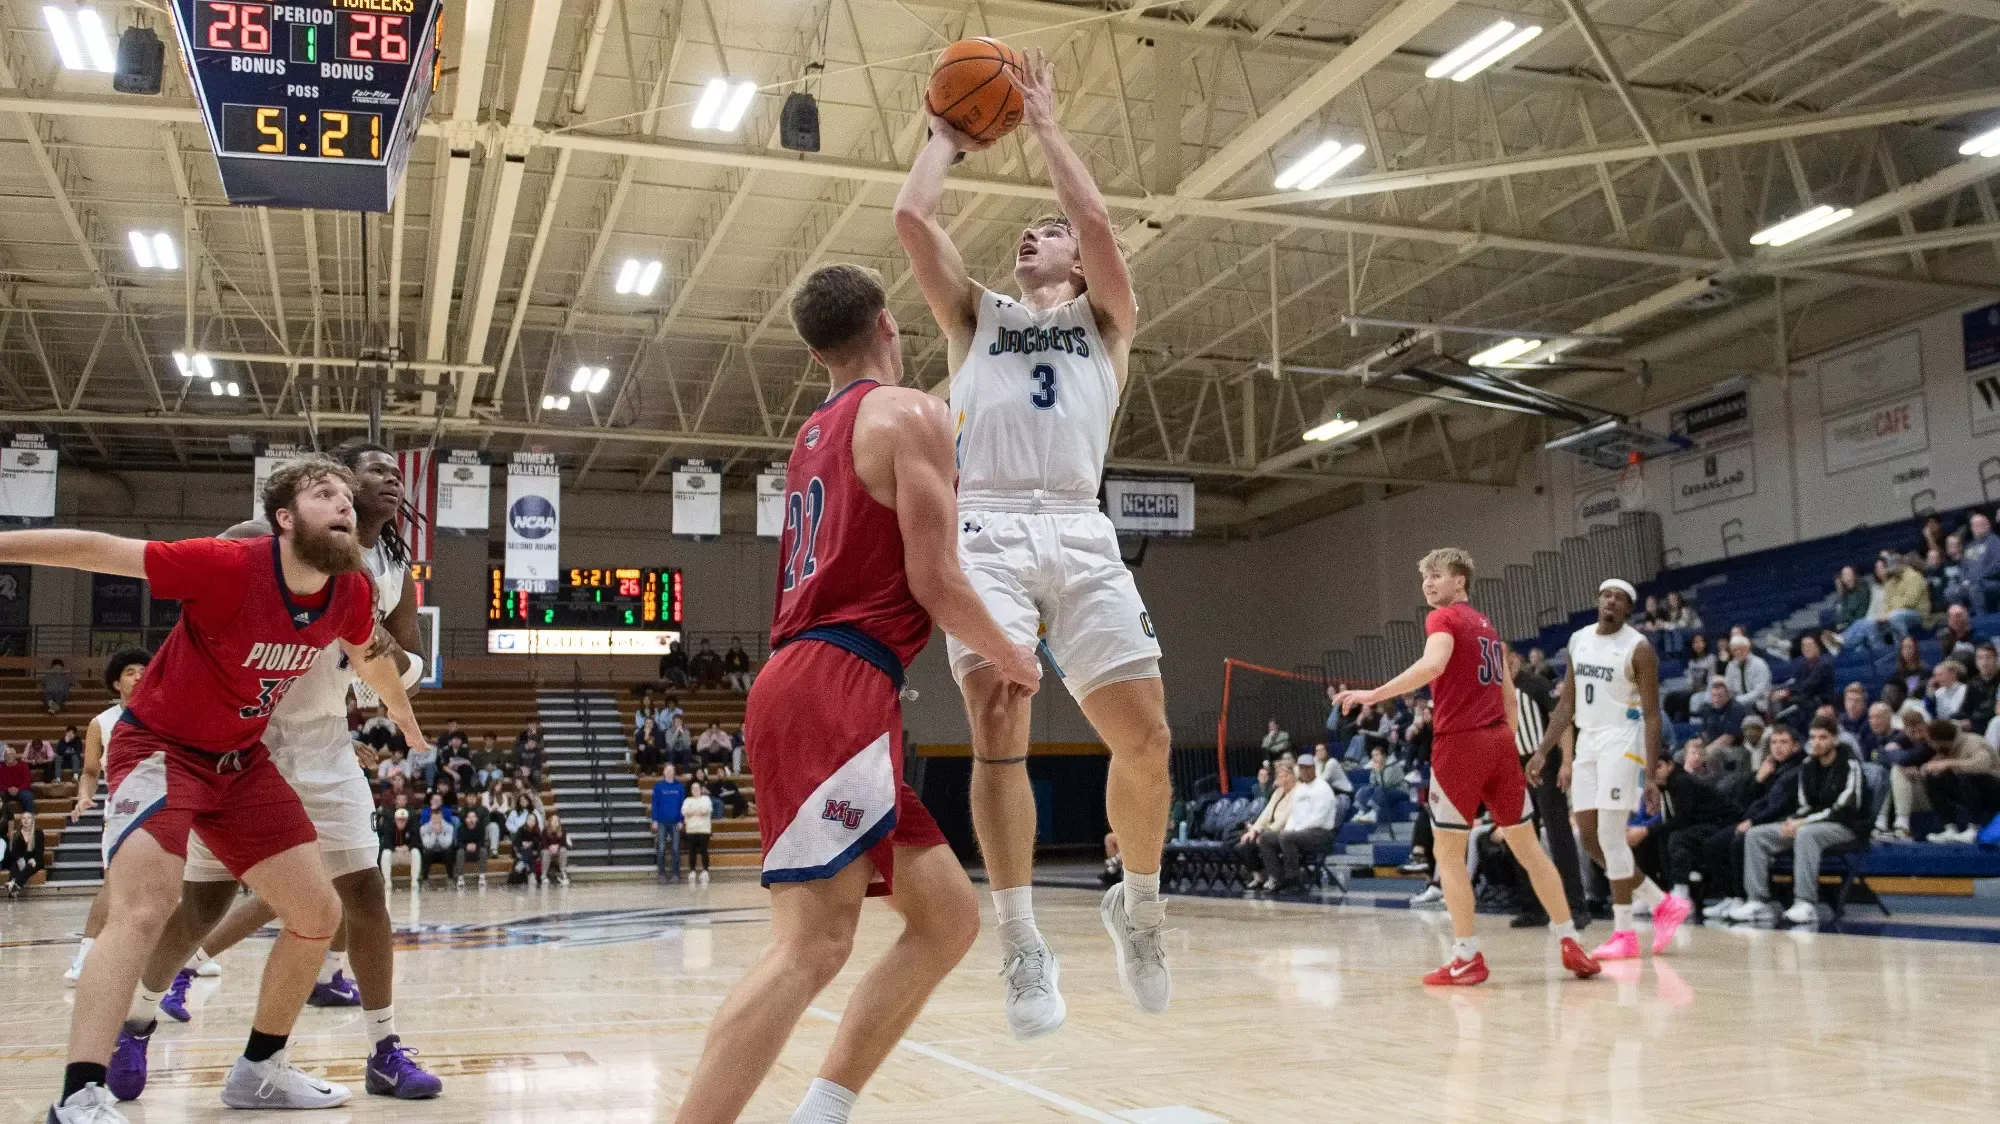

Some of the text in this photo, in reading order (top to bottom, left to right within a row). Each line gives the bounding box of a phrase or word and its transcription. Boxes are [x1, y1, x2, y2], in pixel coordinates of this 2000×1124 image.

[273, 6, 333, 25] PERIOD
[208, 3, 268, 50] 26
[307, 26, 315, 61] 1
[350, 14, 406, 61] 26
[231, 56, 286, 75] BONUS
[320, 62, 374, 81] BONUS
[287, 84, 319, 98] POSS
[256, 107, 379, 159] 5:21
[989, 326, 1089, 358] JACKETS
[1030, 363, 1057, 410] 3
[513, 452, 555, 464] WOMEN'S
[507, 464, 560, 476] VOLLEYBALL
[1122, 494, 1177, 513] NCCAA
[514, 516, 555, 529] NCAA
[783, 476, 825, 592] 22
[507, 542, 557, 551] SECOND ROUND
[516, 579, 546, 593] 2016
[570, 569, 611, 586] 5:21
[620, 579, 640, 596] 26
[544, 609, 554, 623] 2
[624, 610, 634, 624] 5
[1478, 636, 1503, 685] 30
[1585, 683, 1594, 704] 0
[1611, 787, 1621, 800] C
[822, 800, 864, 829] MU
